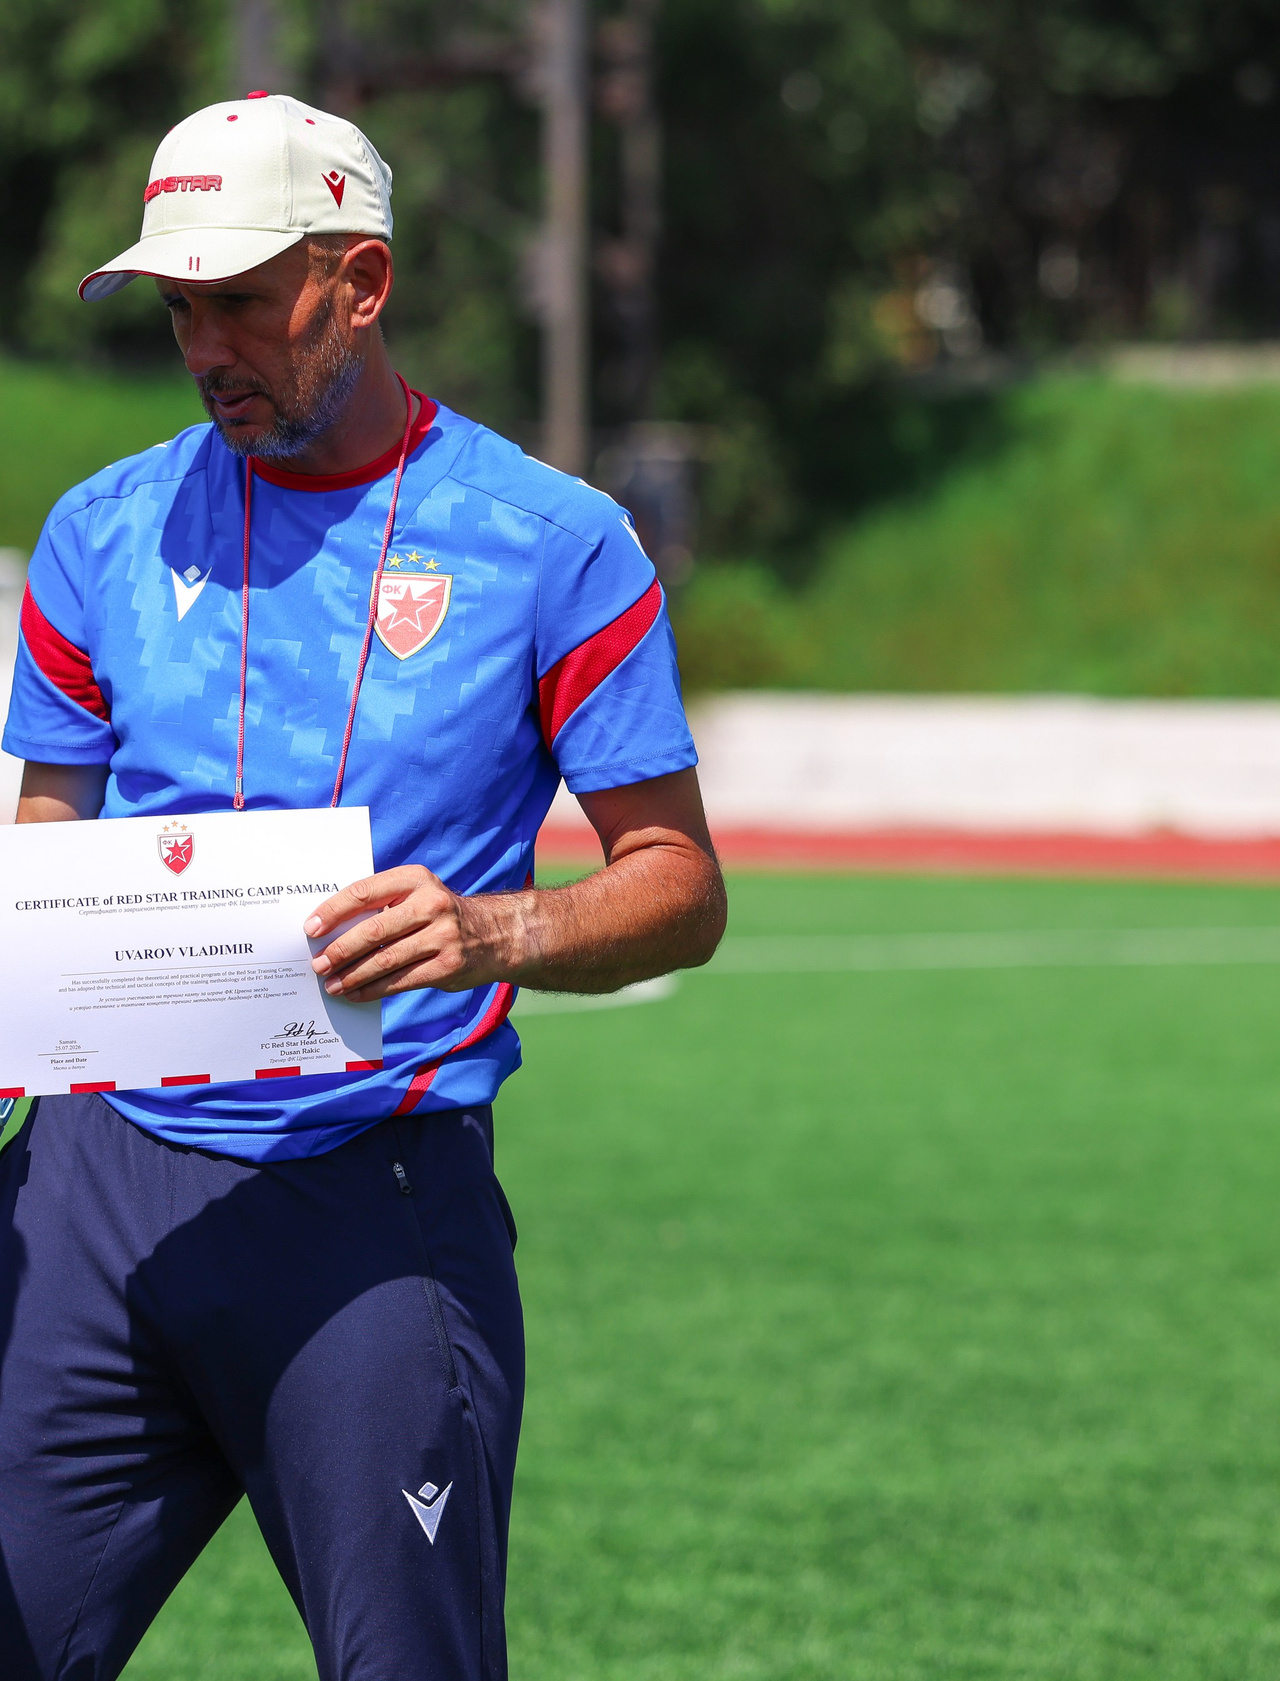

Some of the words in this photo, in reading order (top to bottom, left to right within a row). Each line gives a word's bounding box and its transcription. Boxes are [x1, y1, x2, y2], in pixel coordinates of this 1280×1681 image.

[382, 585, 402, 594] ФК
[16, 897, 100, 910] CERTIFICATE
[104, 896, 113, 905] of
[117, 894, 142, 905] RED
[146, 892, 178, 903] STAR
[180, 888, 244, 901] TRAINING
[248, 886, 284, 897] CAMP
[287, 883, 339, 895] SAMARA
[79, 908, 117, 916] Сертификат
[115, 948, 175, 961] UVAROV
[178, 943, 254, 957] VLADIMIR
